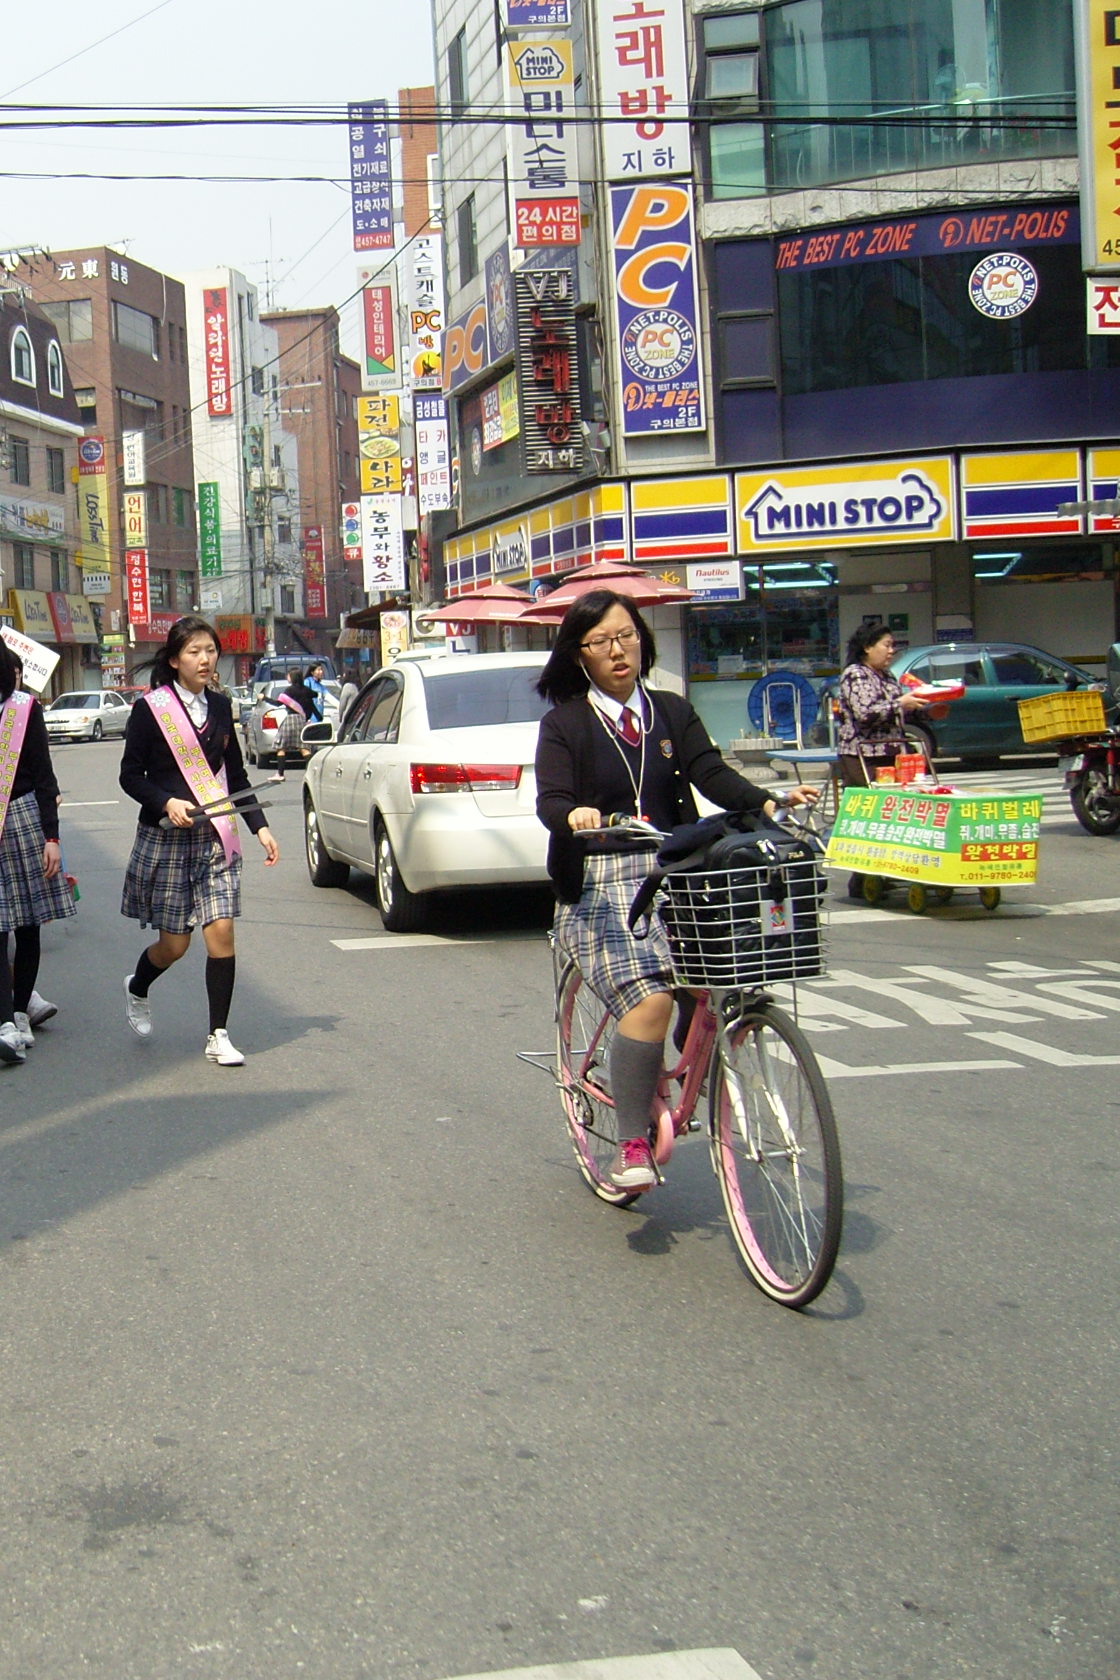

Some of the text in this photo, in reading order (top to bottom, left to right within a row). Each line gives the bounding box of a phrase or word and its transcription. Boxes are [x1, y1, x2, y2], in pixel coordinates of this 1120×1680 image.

[549, 6, 564, 15] 2F
[525, 56, 553, 66] MINI
[525, 65, 555, 76] STOP
[523, 90, 568, 190] 미니스톱
[352, 161, 388, 178] 전기재료
[622, 146, 675, 173] 지하
[518, 206, 578, 225] 24시간
[966, 209, 1070, 245] NET-POLIS
[521, 225, 578, 242] 편의점
[614, 186, 693, 309] PC
[776, 223, 917, 270] THE BEST PC ZONE
[413, 238, 435, 308] 고스트캐슬
[987, 271, 1018, 291] PC
[525, 273, 568, 300] VJ
[411, 309, 441, 334] PC
[629, 311, 692, 340] NET-POLIS
[443, 304, 487, 392] PC
[641, 328, 674, 348] PC
[644, 349, 675, 361] ZONE
[645, 382, 698, 393] THE BEST PC ZONE
[364, 398, 391, 427] 파전
[649, 416, 699, 430] 구의본점
[677, 406, 697, 418] 2F
[537, 448, 575, 469] 지하
[369, 460, 394, 490] 나라
[419, 472, 448, 486] 페인트
[766, 494, 926, 531] MINI STOP
[369, 509, 395, 583] 농부와황소
[844, 794, 951, 828] 바퀴 완전박멸
[959, 800, 1041, 821] 바퀴벌레
